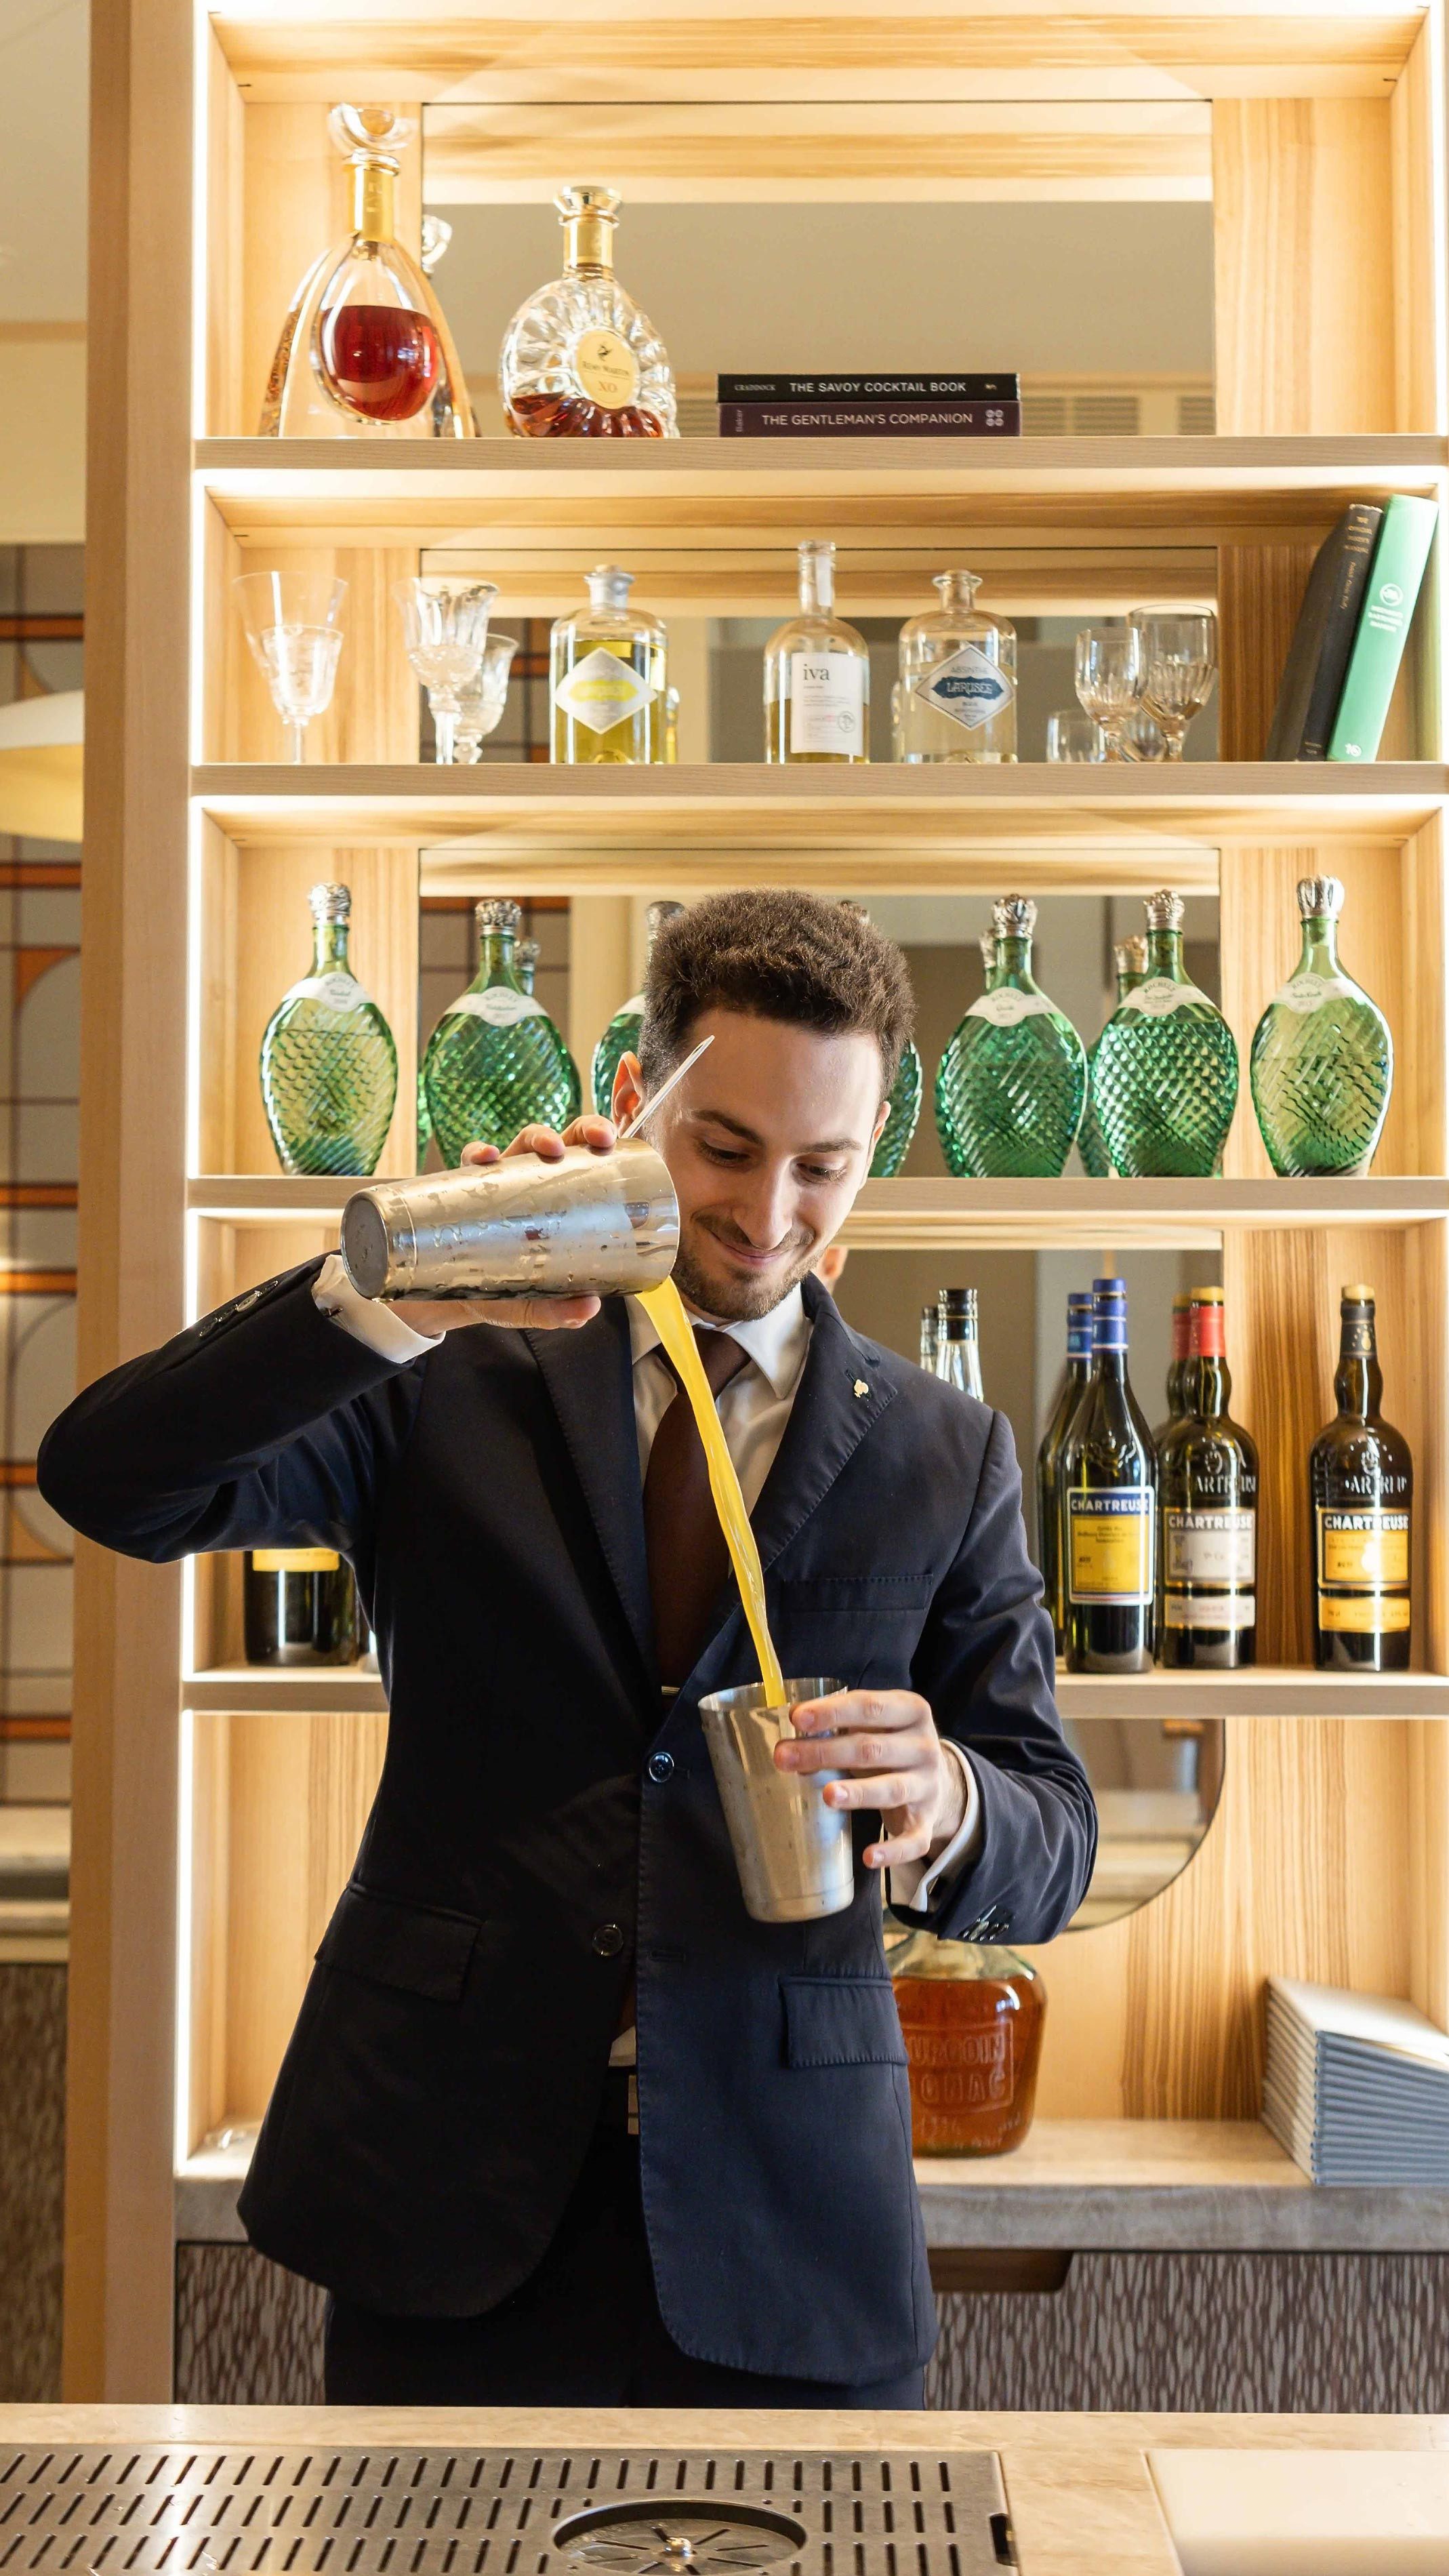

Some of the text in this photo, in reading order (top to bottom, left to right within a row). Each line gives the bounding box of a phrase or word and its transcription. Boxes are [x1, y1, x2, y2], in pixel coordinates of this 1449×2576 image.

[598, 380, 618, 393] XO
[789, 382, 966, 393] THE SAVOY COCKTAIL BOOK
[762, 413, 973, 425] THE GENTLEMAN'S COMPANION
[802, 663, 830, 681] iva
[1071, 1497, 1149, 1512] CHARTREUSE
[1168, 1514, 1253, 1529] CHARTREUSE
[1324, 1514, 1409, 1530] CHARTREUSE
